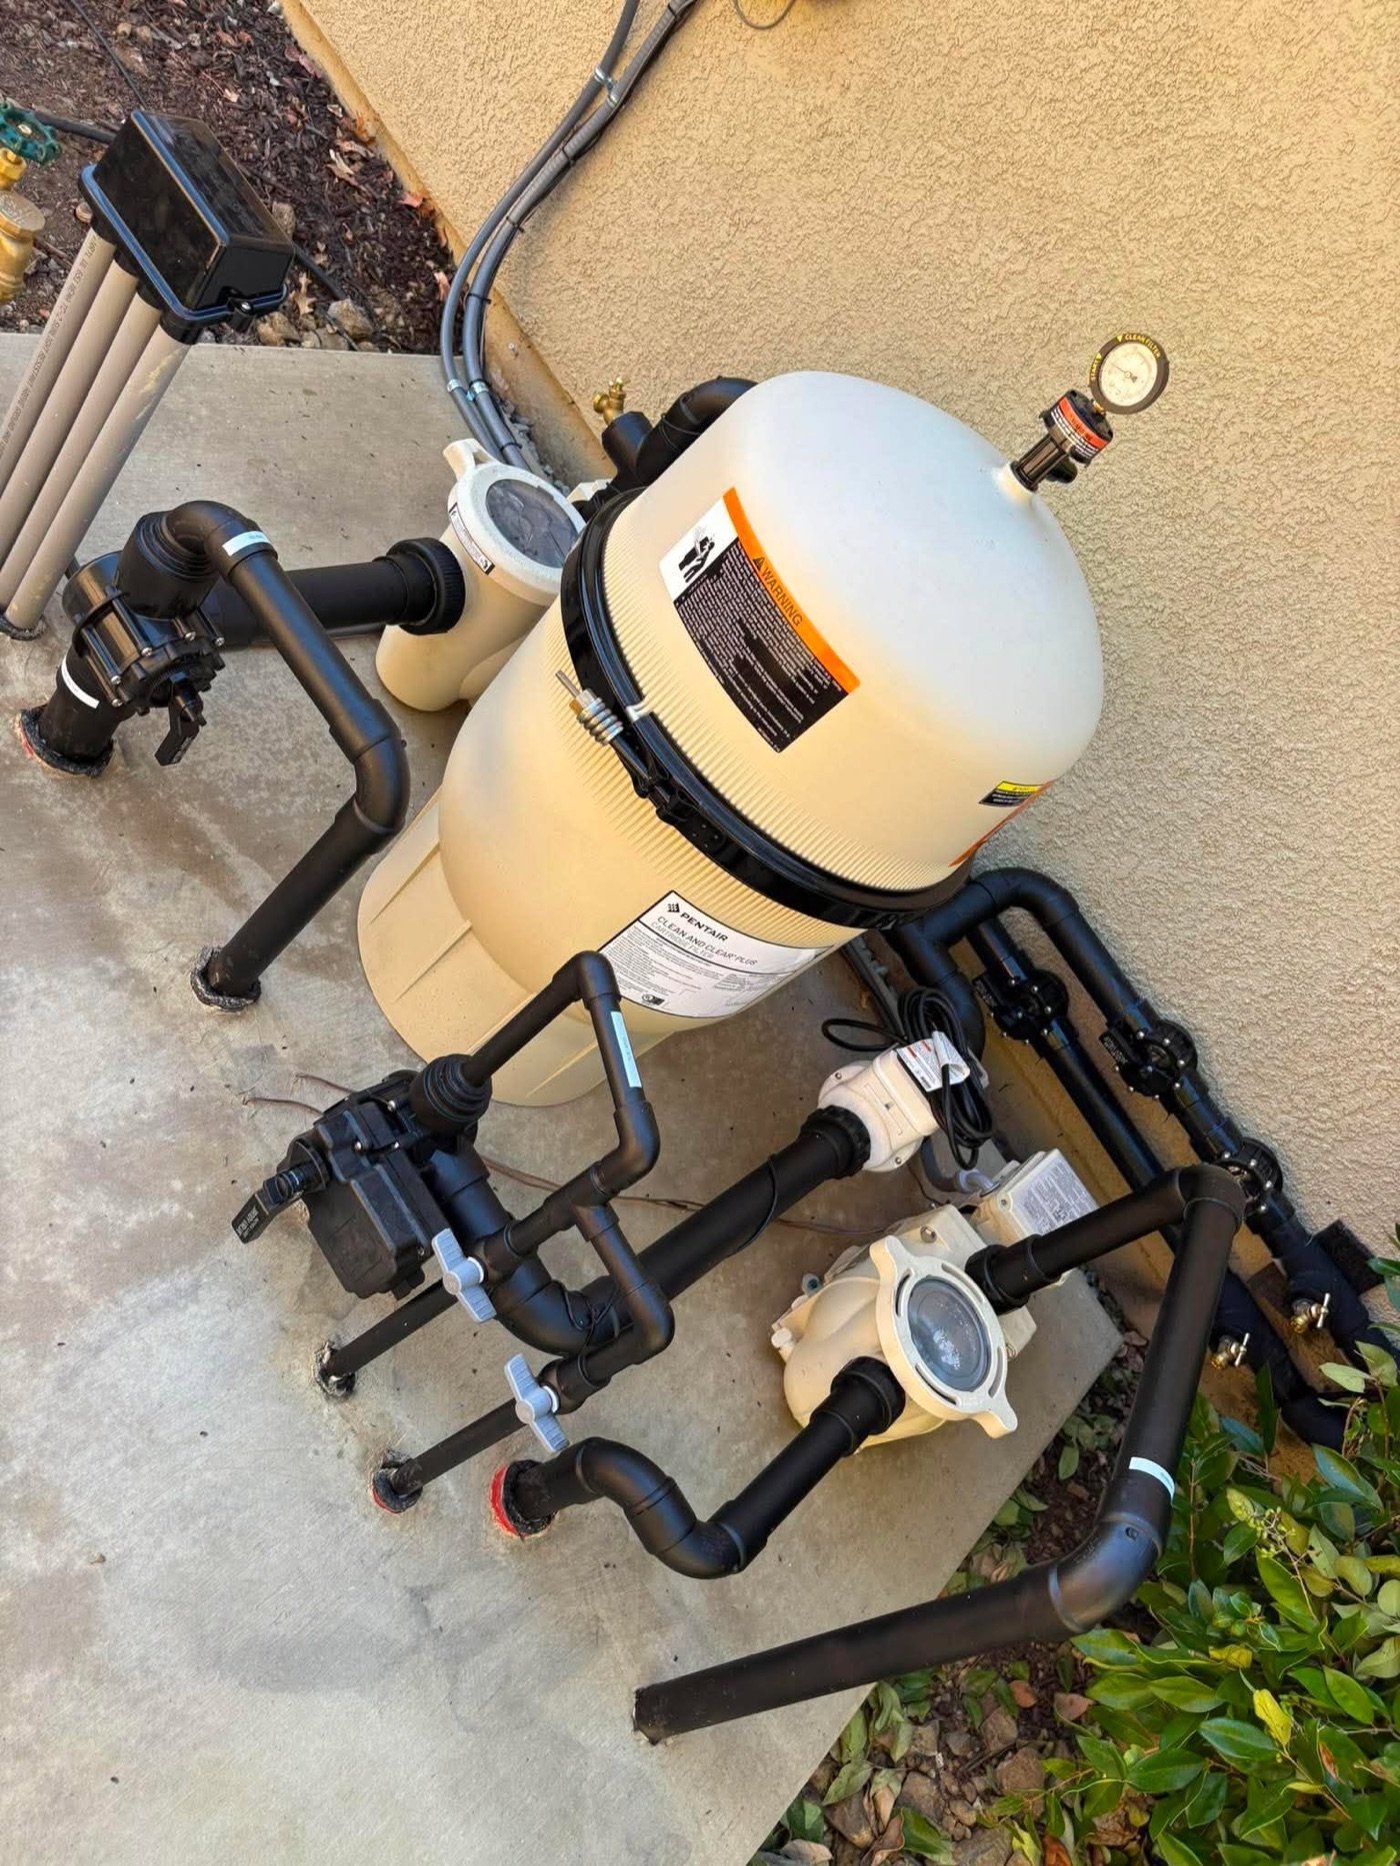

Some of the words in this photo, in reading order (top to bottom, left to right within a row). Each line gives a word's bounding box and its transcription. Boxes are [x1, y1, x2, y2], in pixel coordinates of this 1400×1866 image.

[762, 567, 803, 627] WARNING
[657, 915, 688, 938] CLEAN
[686, 935, 706, 948] AND
[680, 912, 729, 942] PENTAIR
